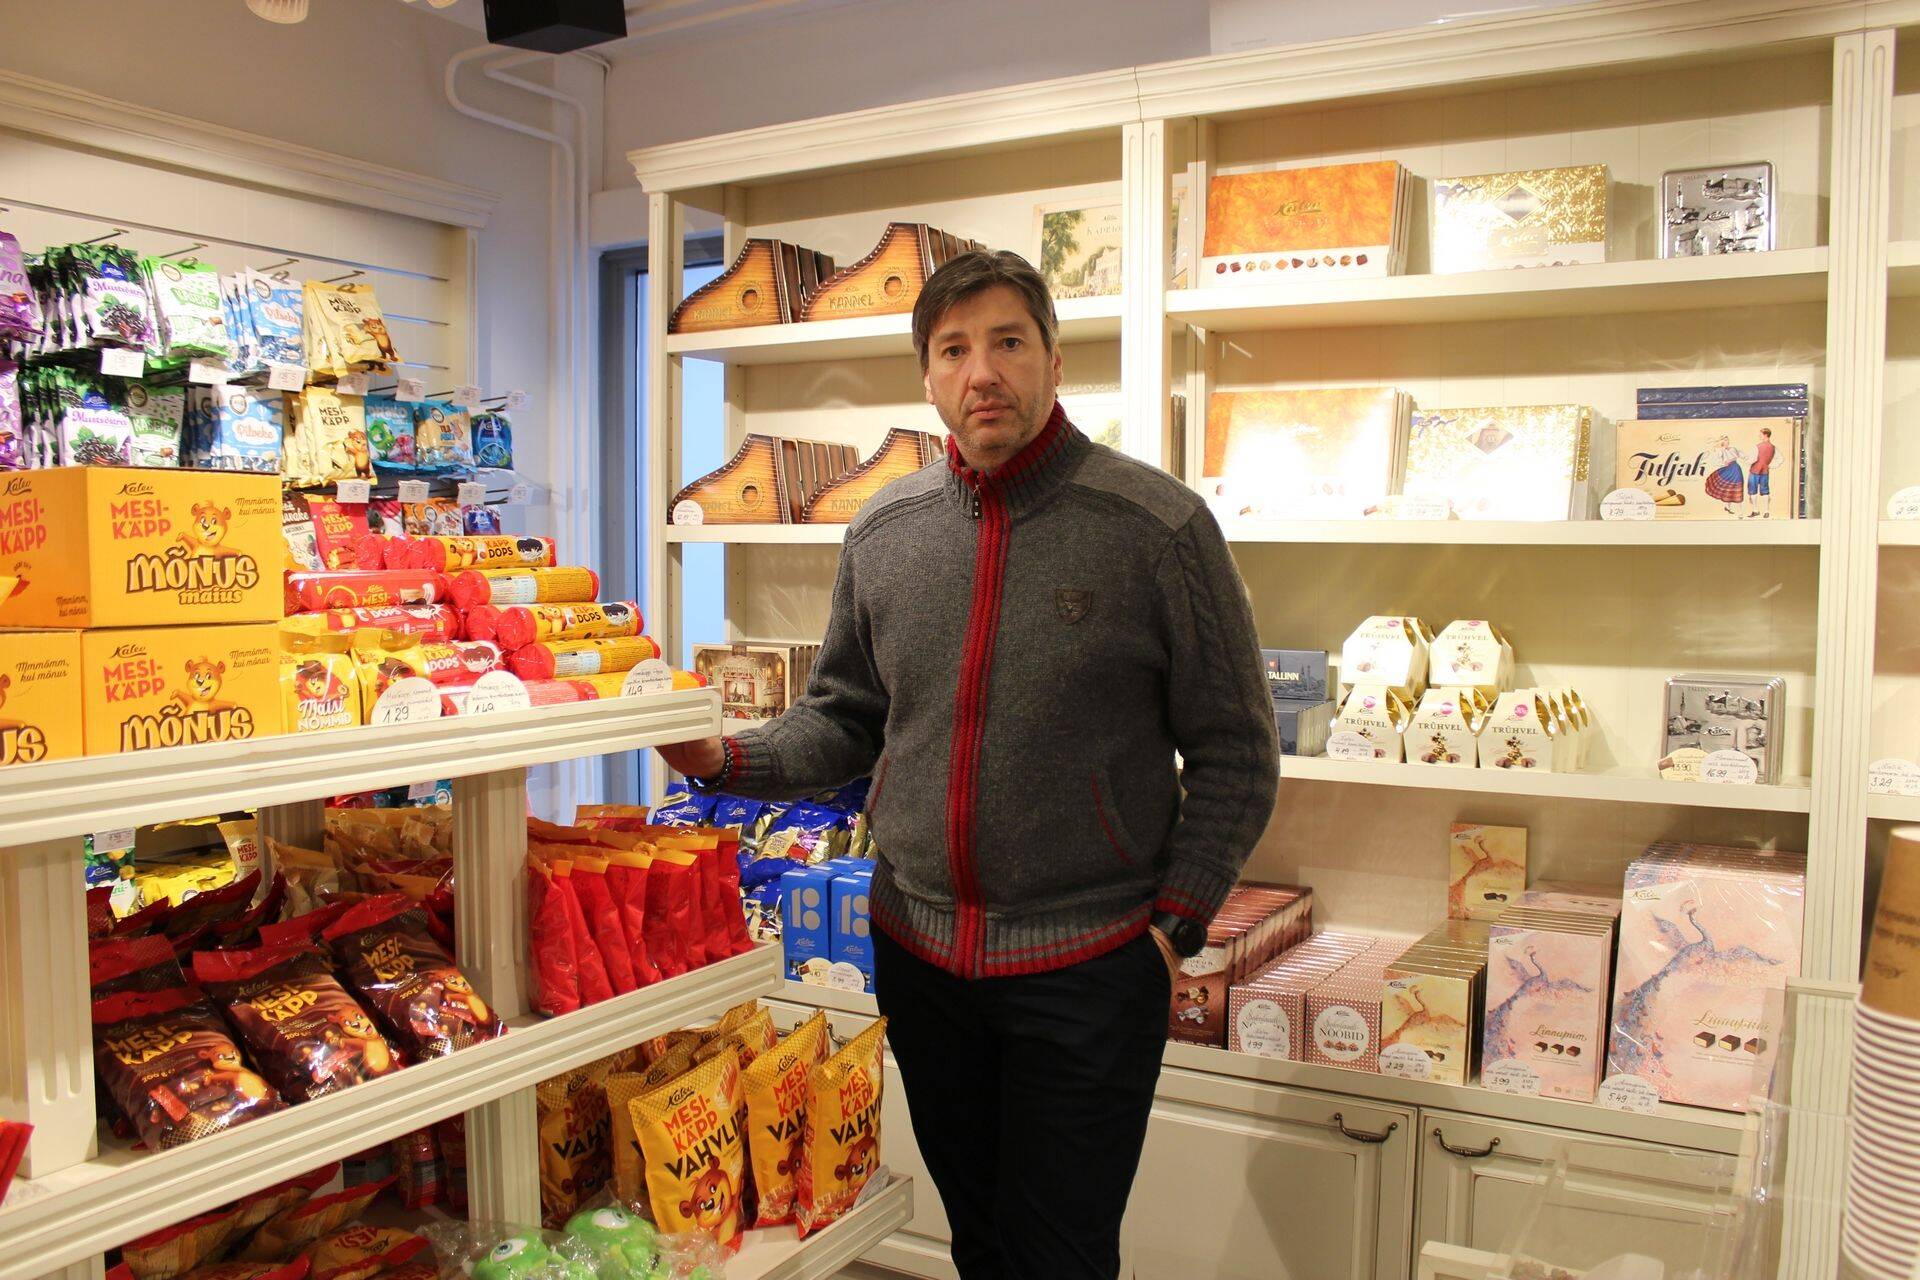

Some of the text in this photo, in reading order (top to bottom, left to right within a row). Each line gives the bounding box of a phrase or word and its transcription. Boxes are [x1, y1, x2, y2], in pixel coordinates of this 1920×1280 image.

[829, 293, 874, 309] KANNEL
[1629, 451, 1706, 486] Tuljak
[110, 499, 170, 519] MESI-
[112, 520, 172, 540] KÄPP
[488, 547, 513, 558] DOPS
[126, 546, 259, 594] MÕNUS
[179, 585, 243, 605] maius
[369, 607, 401, 619] DOPS
[577, 612, 601, 623] DOPS
[103, 659, 163, 682] MESI-
[429, 657, 459, 671] DOPS
[1268, 671, 1299, 681] TALLINN
[105, 679, 165, 704] KÄPP
[120, 703, 254, 753] MÕNUS
[1418, 722, 1463, 731] TRÜHVEL
[1492, 727, 1538, 735] TRÜHVEL
[1320, 1028, 1364, 1041] NOOBID
[665, 1085, 696, 1112] Kalev
[662, 1095, 711, 1136] MESI-
[672, 1111, 718, 1155] KÄPP
